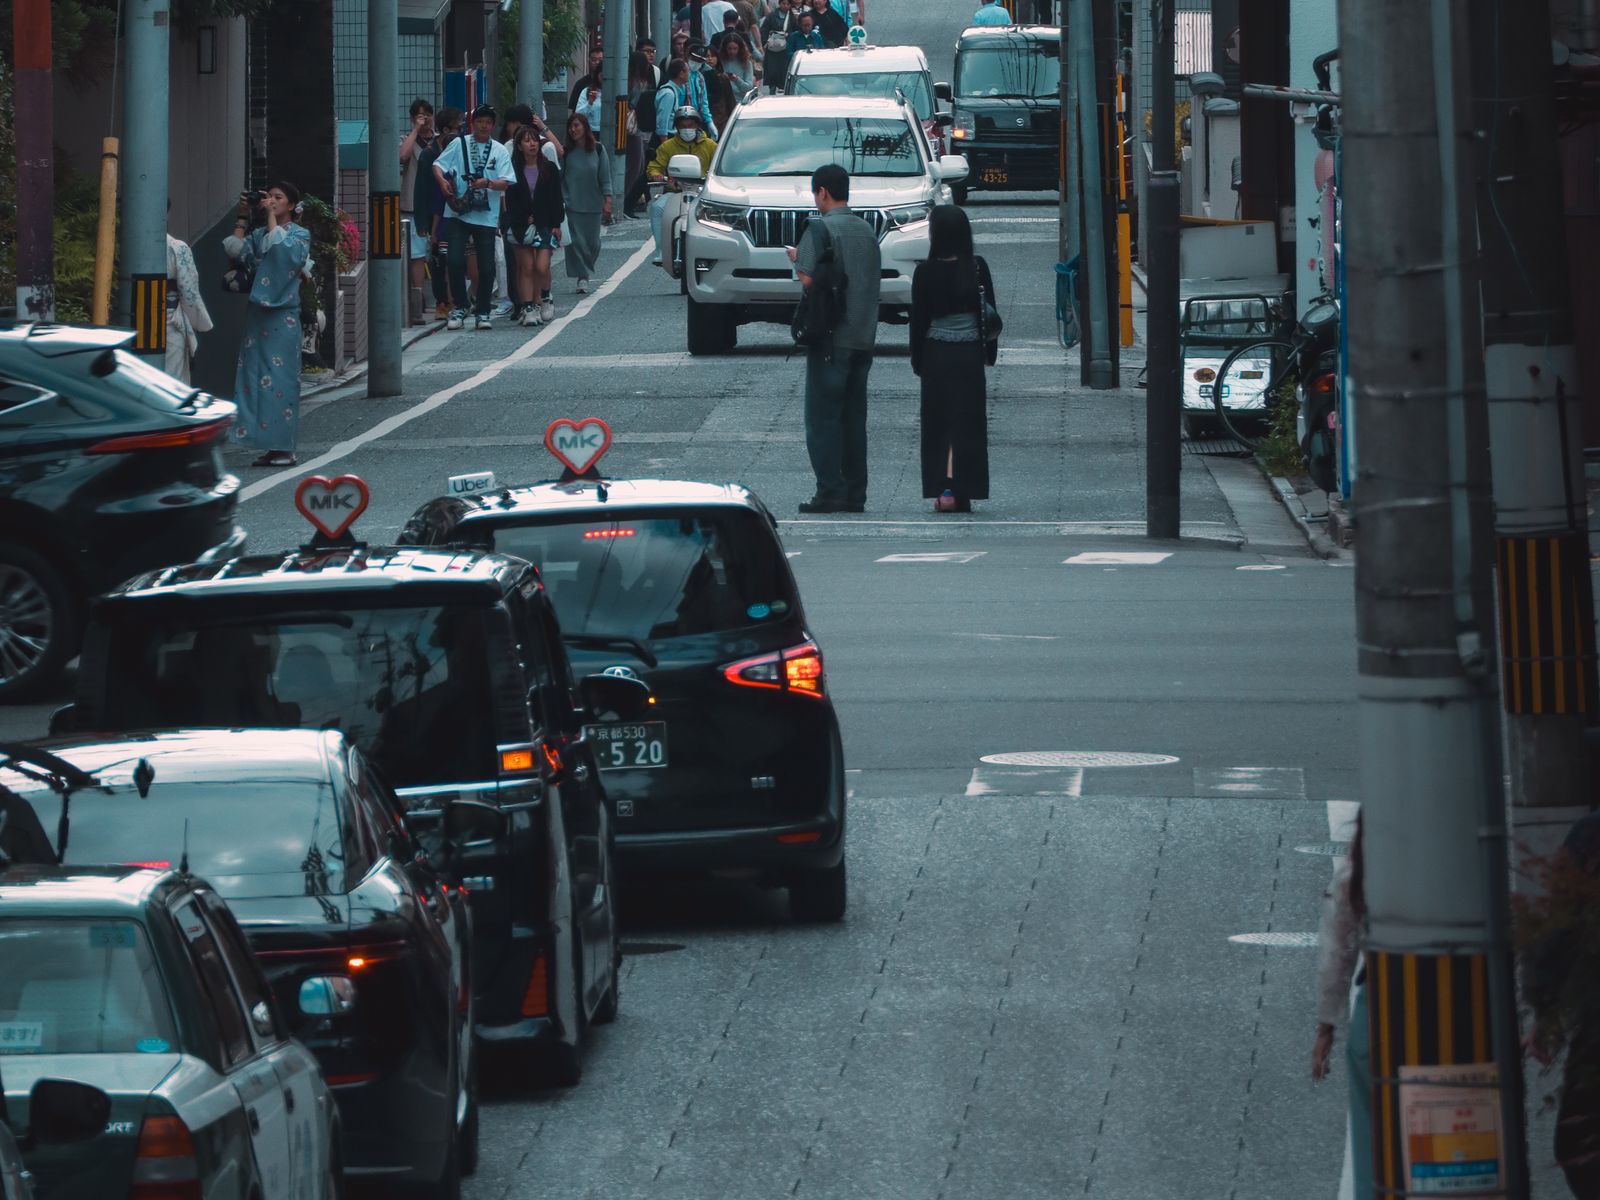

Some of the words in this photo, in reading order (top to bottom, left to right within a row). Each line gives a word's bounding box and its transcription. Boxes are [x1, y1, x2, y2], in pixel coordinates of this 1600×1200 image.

[559, 433, 598, 450] MK
[453, 477, 490, 494] Uber
[309, 494, 354, 511] MK
